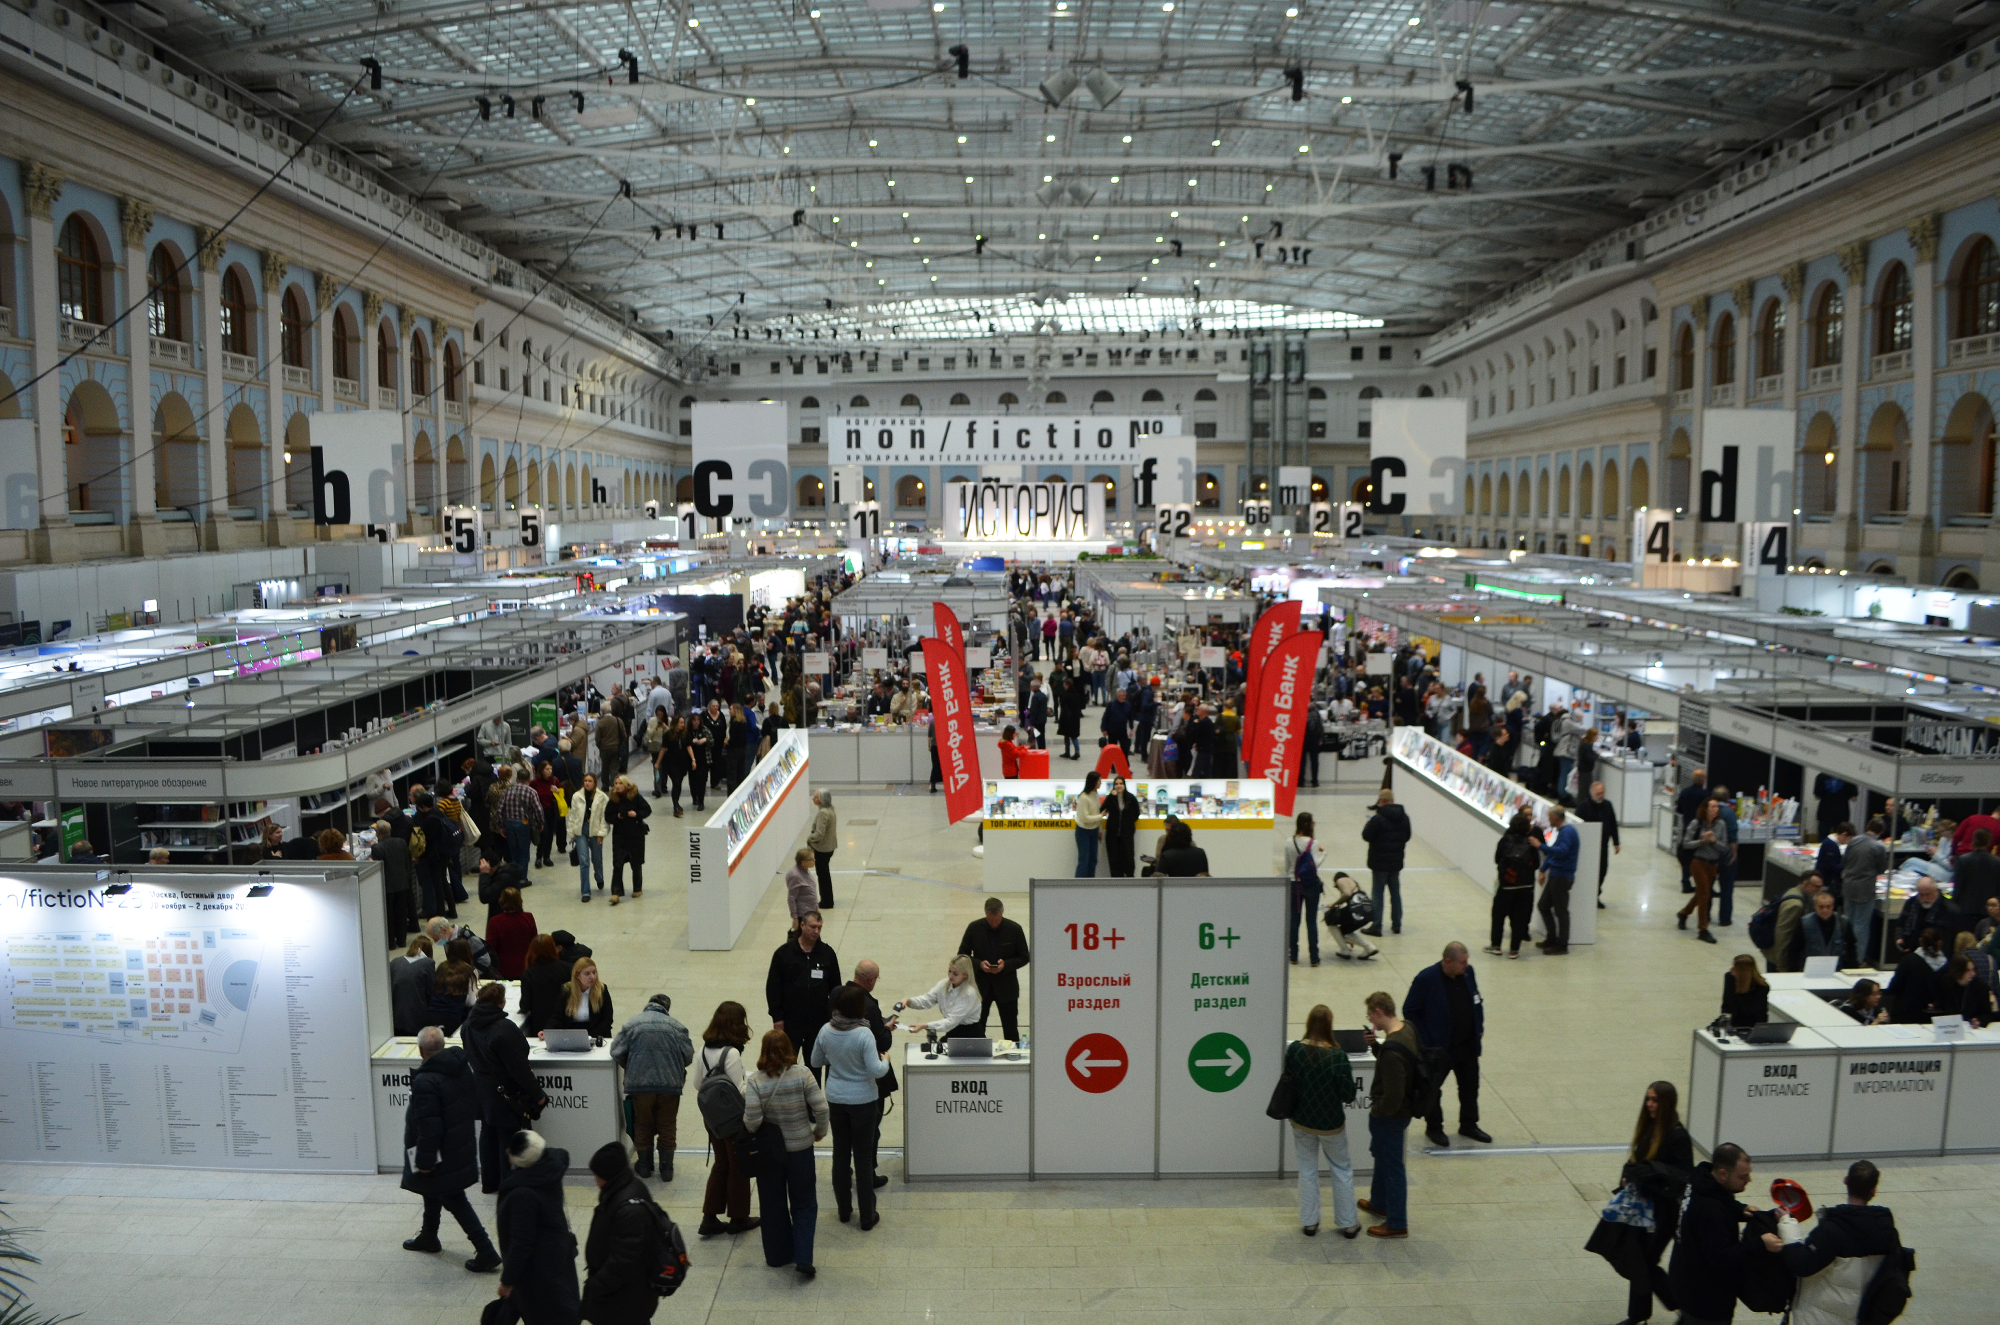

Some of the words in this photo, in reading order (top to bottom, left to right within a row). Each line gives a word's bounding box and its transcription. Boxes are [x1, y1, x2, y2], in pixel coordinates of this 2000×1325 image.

[919, 453, 1063, 462] ИНТЕЛЛЕКТУАЛЬНОЙ
[962, 484, 1085, 538] ИСТОРИЯ
[1315, 511, 1329, 532] 2
[1346, 512, 1361, 538] 2
[455, 518, 475, 553] 5
[521, 515, 538, 546] 5
[1646, 522, 1670, 562] 4
[1760, 526, 1787, 575] 4
[1273, 654, 1300, 710] Банк
[1263, 713, 1292, 788] Альфа
[72, 777, 98, 787] Новое
[101, 779, 159, 790] литературное
[162, 778, 207, 789] обозрение
[1033, 820, 1072, 828] КОМИКСЫ
[690, 832, 701, 884] ТОП-ЛИСТ
[181, 891, 215, 899] Гостиный
[217, 892, 235, 900] двор
[203, 902, 233, 911] декабря
[1064, 922, 1126, 950] 18+
[1199, 922, 1241, 950] 6+
[1057, 972, 1131, 989] Взрослый
[1190, 972, 1250, 989] Детский
[1068, 998, 1120, 1012] раздел
[1194, 997, 1247, 1011] раздел
[1763, 1065, 1798, 1079] ВХОД
[1850, 1060, 1941, 1075] ИНФОРМАЦИЯ
[538, 1076, 573, 1091] ВХОД
[951, 1081, 988, 1095] ВХОД
[1747, 1083, 1810, 1097] ENTRANCE
[1853, 1079, 1935, 1094] INFORMATION
[546, 1096, 589, 1108] RANCE
[936, 1100, 1003, 1113] ENTRANCE
